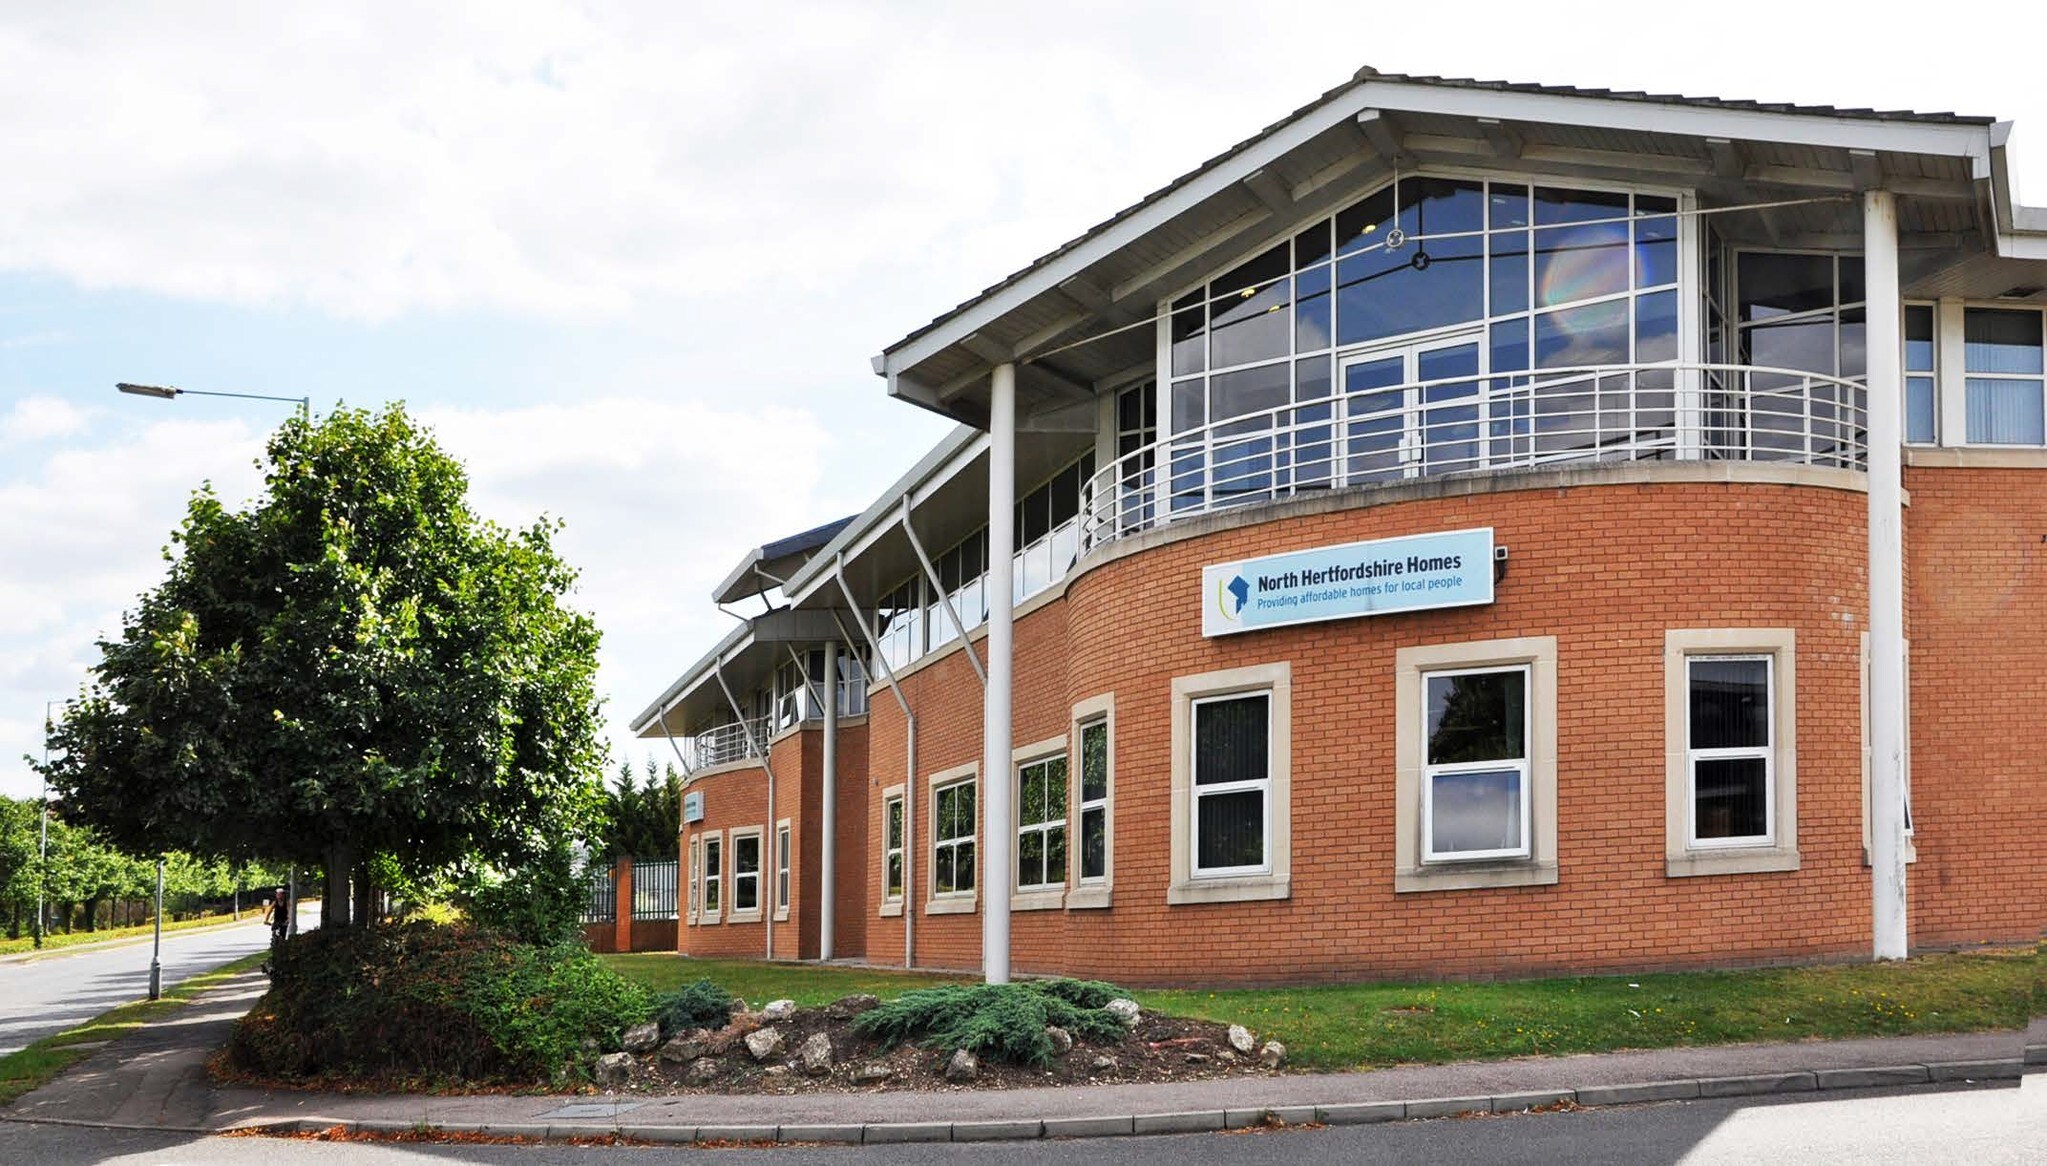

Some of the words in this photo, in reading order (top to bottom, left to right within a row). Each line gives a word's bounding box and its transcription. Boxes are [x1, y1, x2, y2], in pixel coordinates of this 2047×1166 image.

[1258, 571, 1298, 592] North
[1301, 560, 1403, 586] Hertfordshire
[1407, 555, 1462, 573] Homes
[1257, 594, 1298, 610] Providing
[1300, 588, 1347, 603] affordable
[1350, 585, 1382, 597] homes
[1385, 582, 1399, 594] for
[1401, 578, 1425, 593] local
[1428, 575, 1462, 592] people
